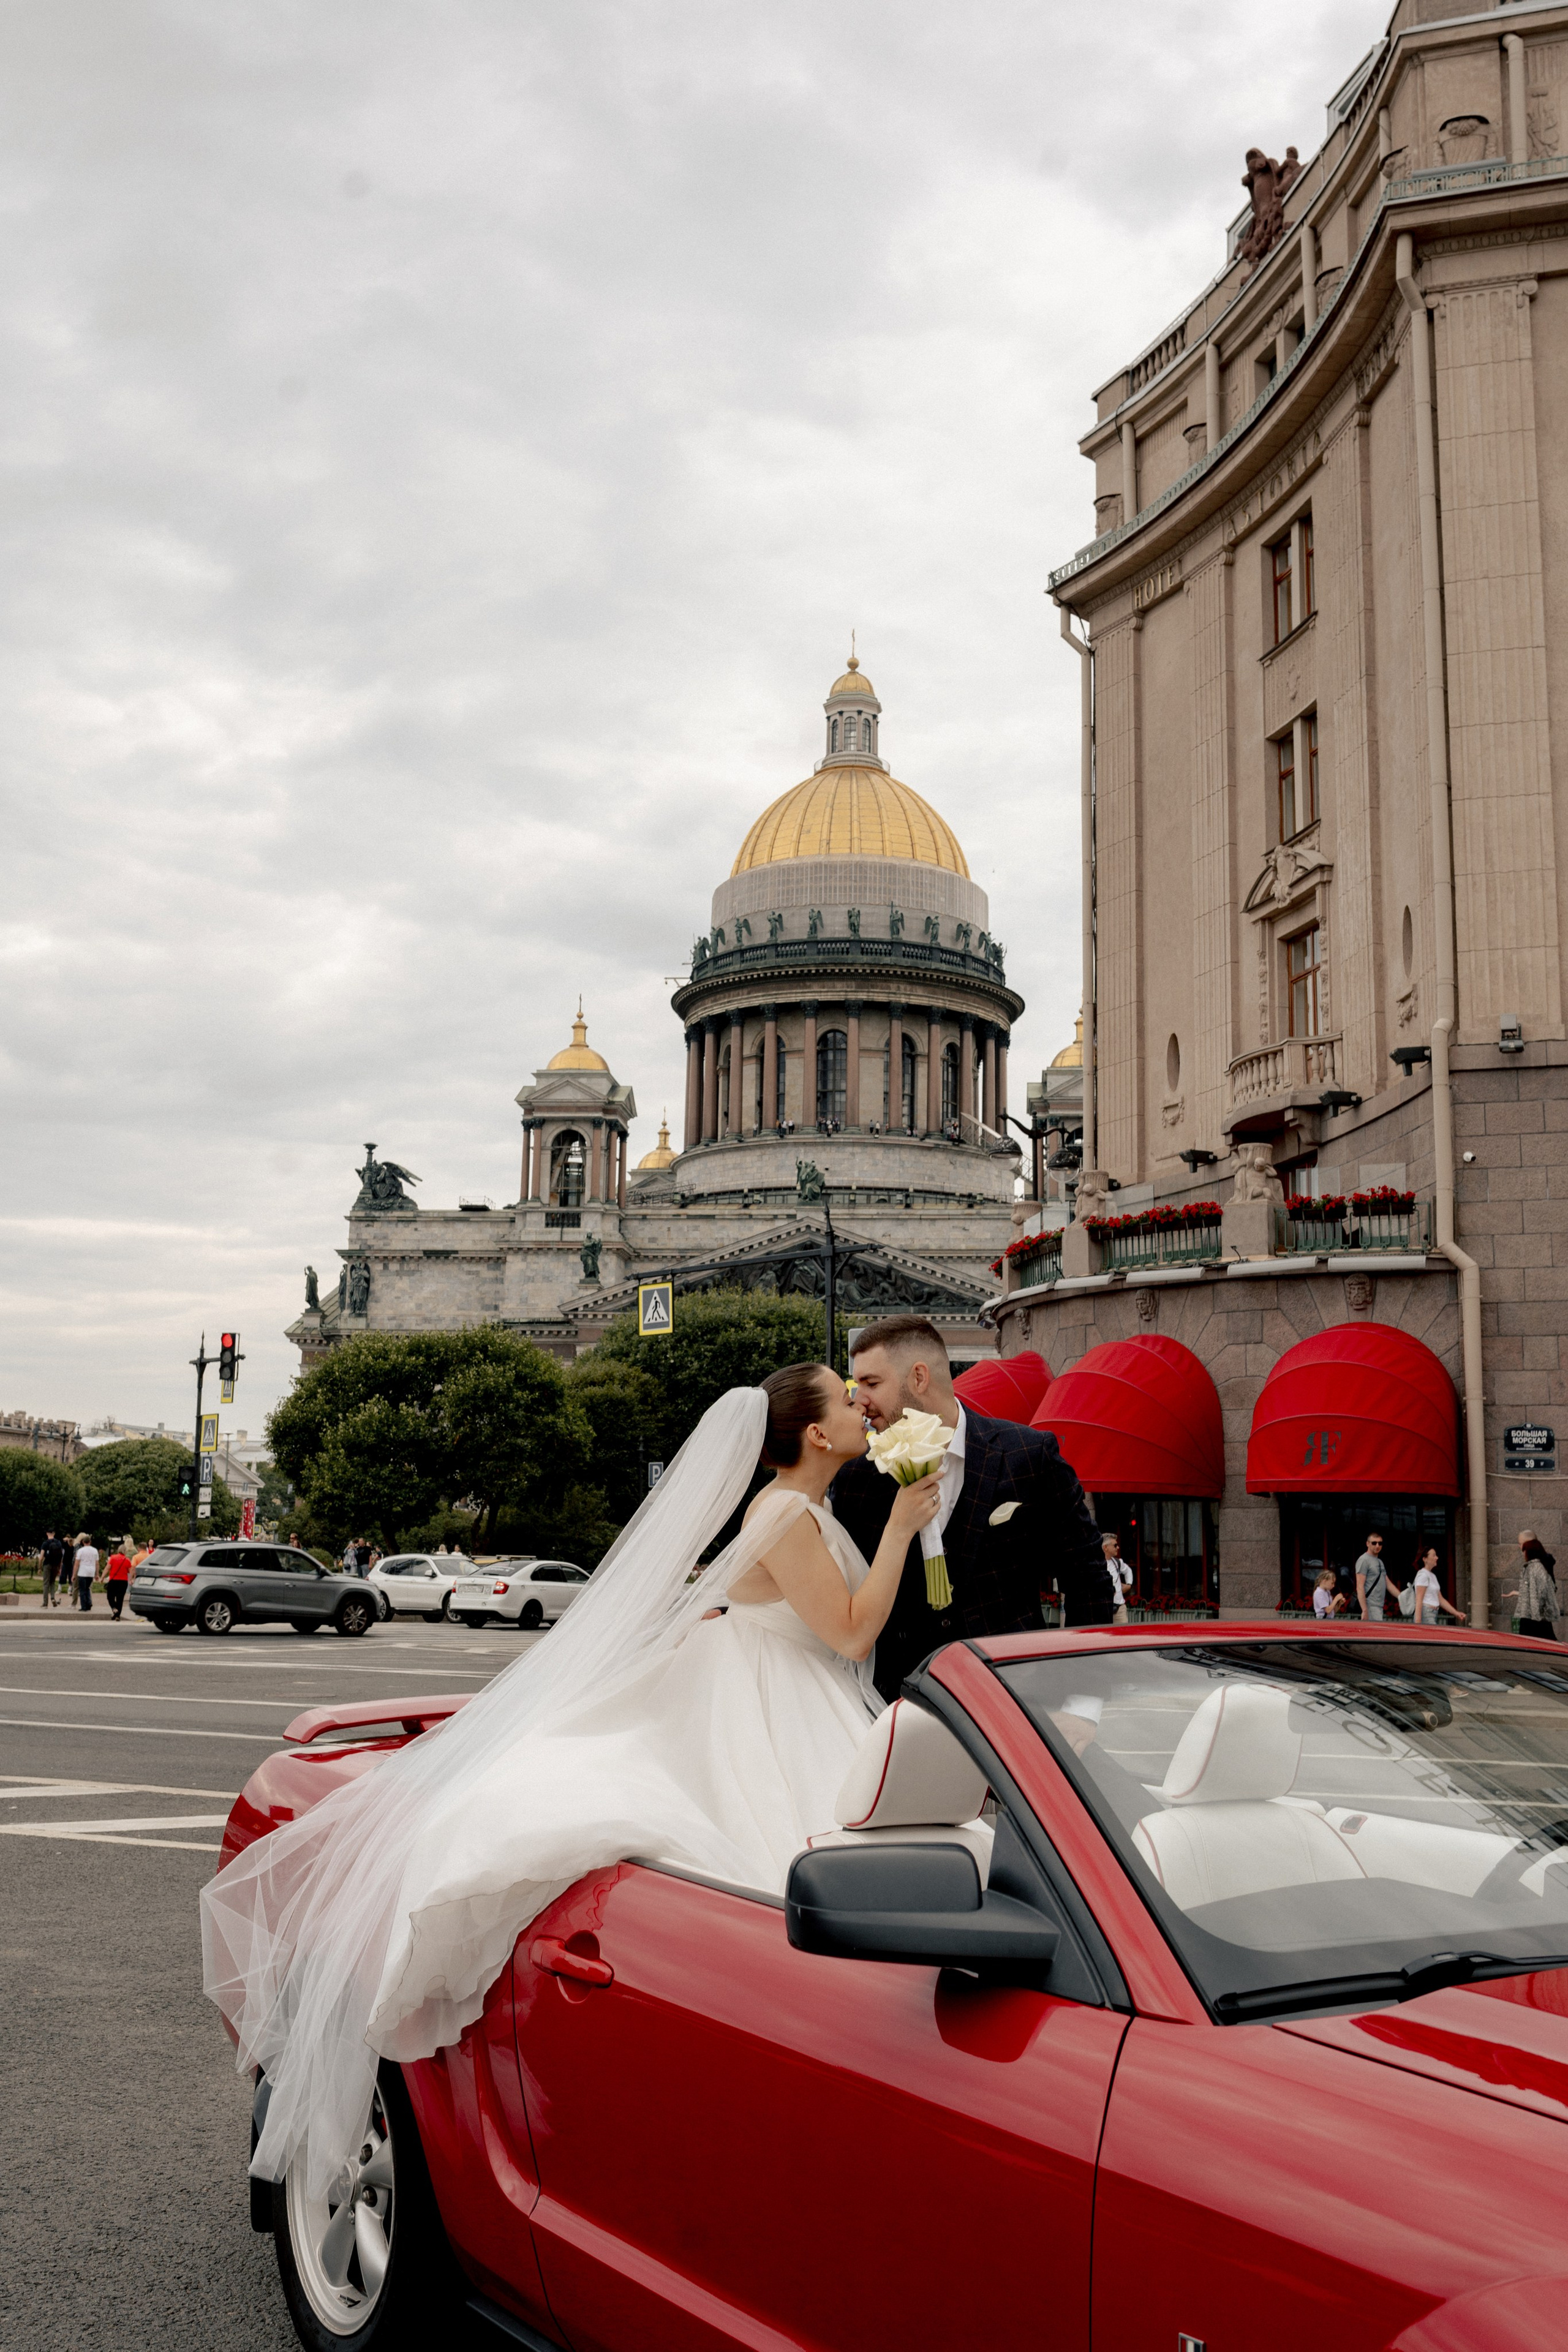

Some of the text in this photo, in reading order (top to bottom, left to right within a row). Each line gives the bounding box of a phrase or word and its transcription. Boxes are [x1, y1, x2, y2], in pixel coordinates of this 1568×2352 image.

[1134, 558, 1182, 609] HOTEL
[1227, 429, 1325, 541] ASTORIA
[1525, 1459, 1534, 1468] 39
[652, 1465, 660, 1484] P
